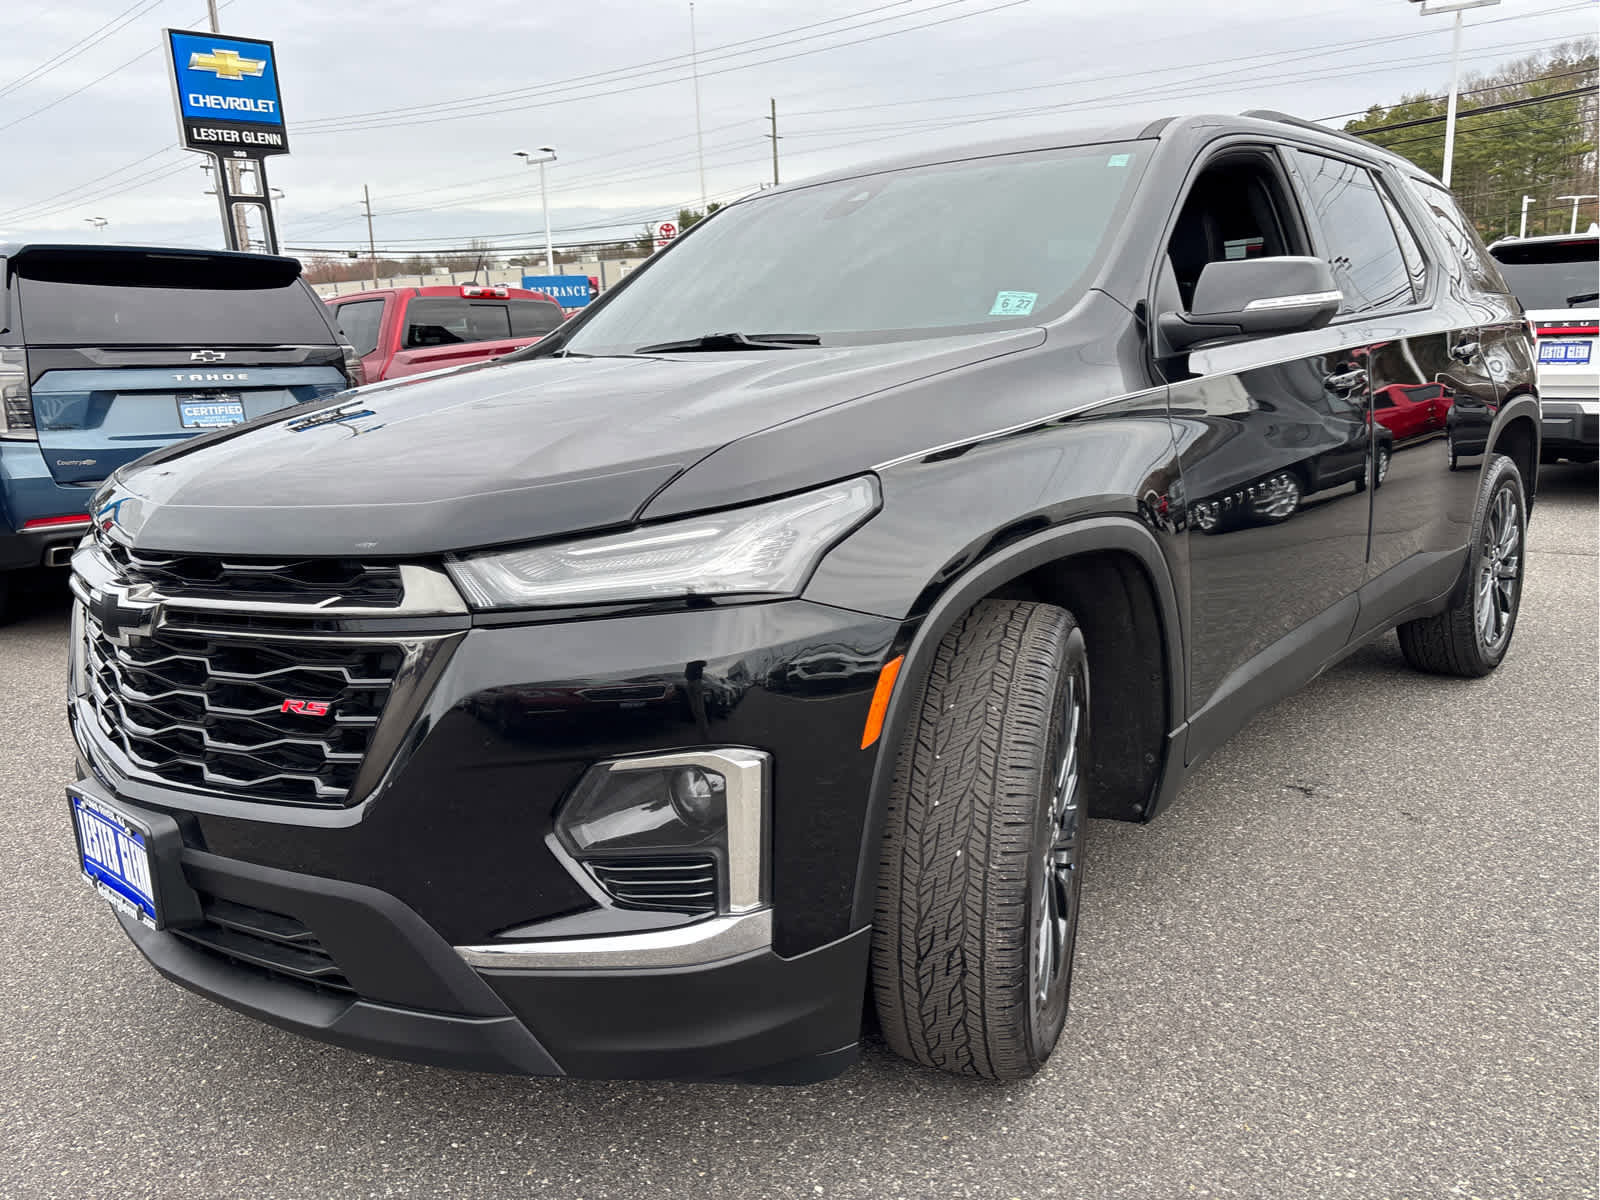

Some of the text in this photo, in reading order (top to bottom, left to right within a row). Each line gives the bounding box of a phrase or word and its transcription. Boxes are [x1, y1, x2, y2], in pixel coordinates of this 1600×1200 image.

[188, 93, 276, 113] CHEVROLET
[193, 127, 282, 146] LESTER GLENN
[1001, 298, 1033, 310] 6 27
[174, 373, 249, 382] TAHOE
[184, 405, 243, 417] CERTIFIED
[280, 699, 330, 717] RS
[76, 808, 122, 876] LESTER
[117, 832, 155, 904] GLENN
